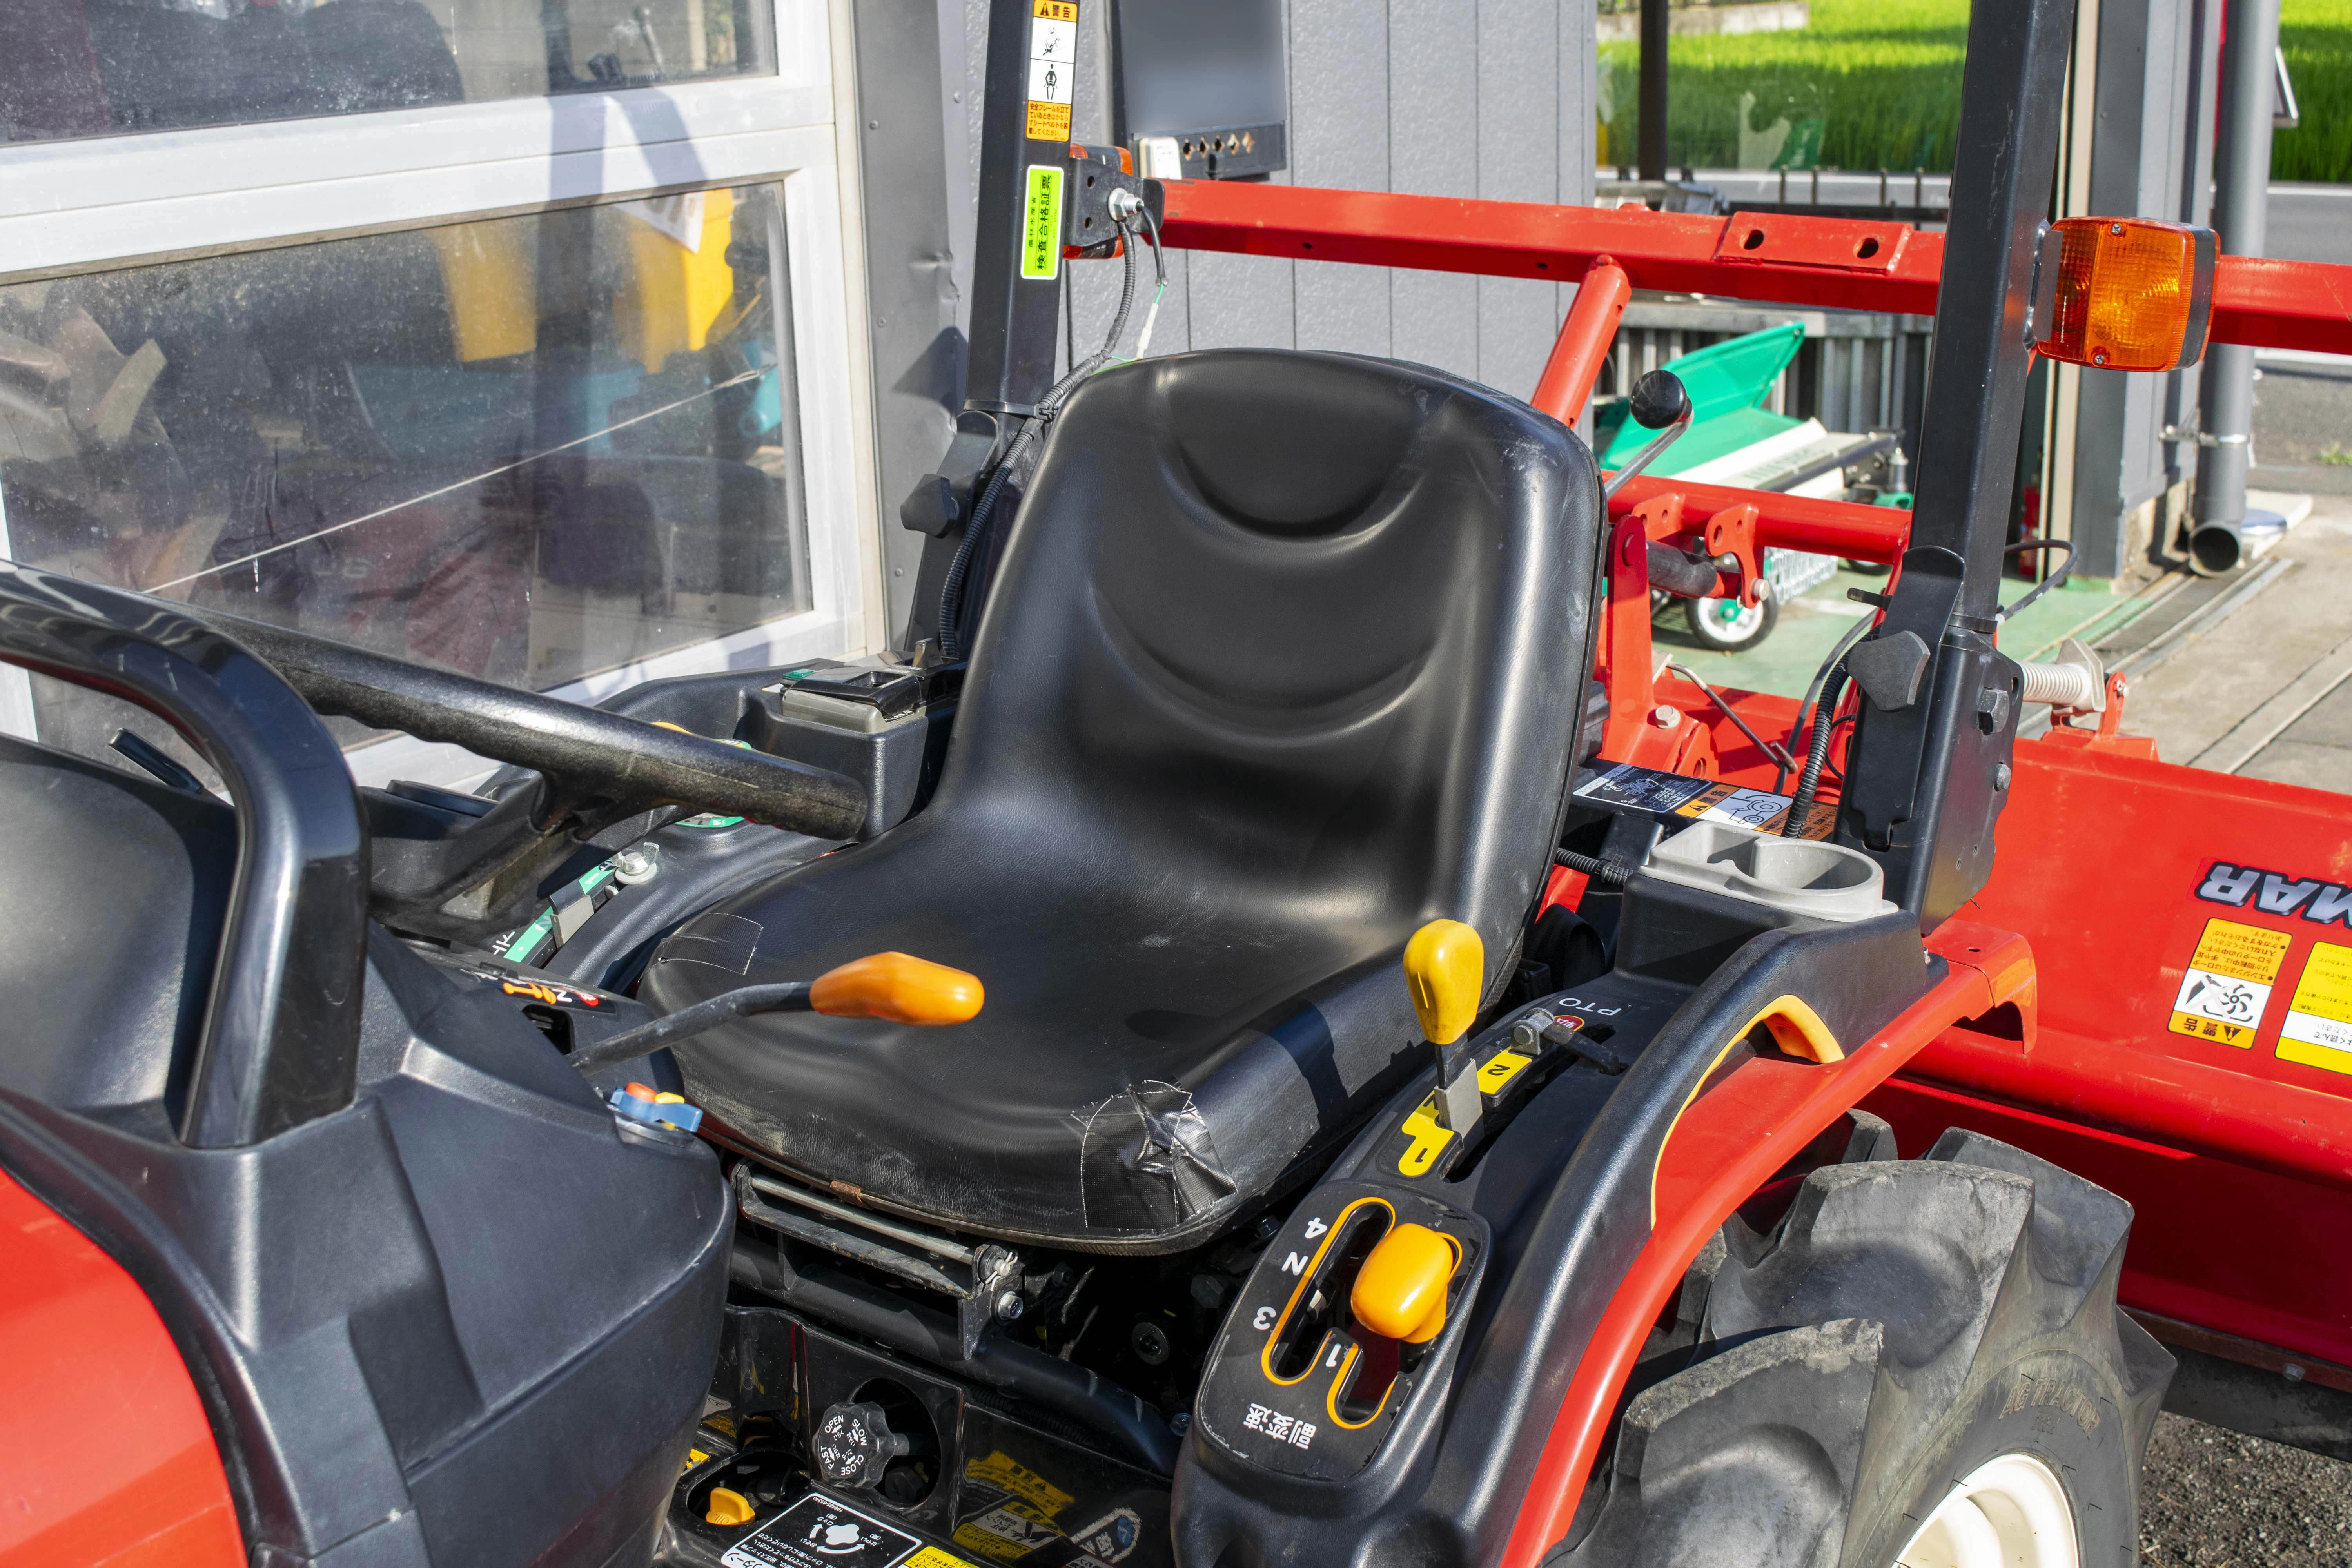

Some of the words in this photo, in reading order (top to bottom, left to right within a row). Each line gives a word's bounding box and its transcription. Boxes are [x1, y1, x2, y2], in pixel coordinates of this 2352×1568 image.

[1053, 4, 1071, 18] 警告
[1030, 103, 1069, 113] 安全フレームを立て
[1030, 111, 1069, 122] ているときはかなら
[1037, 174, 1051, 270] 検査合格証票
[1559, 998, 1622, 1016] PTO
[2182, 1016, 2219, 1036] 警告
[1487, 1063, 1511, 1076] 2
[1305, 1217, 1328, 1239] 4
[1282, 1252, 1309, 1276] N
[1253, 1306, 1277, 1330] 3
[1326, 1343, 1341, 1367] 1
[1998, 1381, 2030, 1420] AG
[2030, 1377, 2100, 1440] TRACTOR
[825, 1415, 844, 1433] OPEN
[852, 1419, 867, 1446] SLOW
[1243, 1403, 1317, 1450] 副変速
[821, 1446, 834, 1470] FAST
[841, 1454, 864, 1475] CLOSE
[815, 1515, 835, 1526] ロック
[754, 1532, 838, 1568] は、ロック(閉)にしないでくださ
[799, 1537, 818, 1547] おそい
[859, 1536, 879, 1546] はやい
[749, 1539, 818, 1568] ルブで行なってください。
